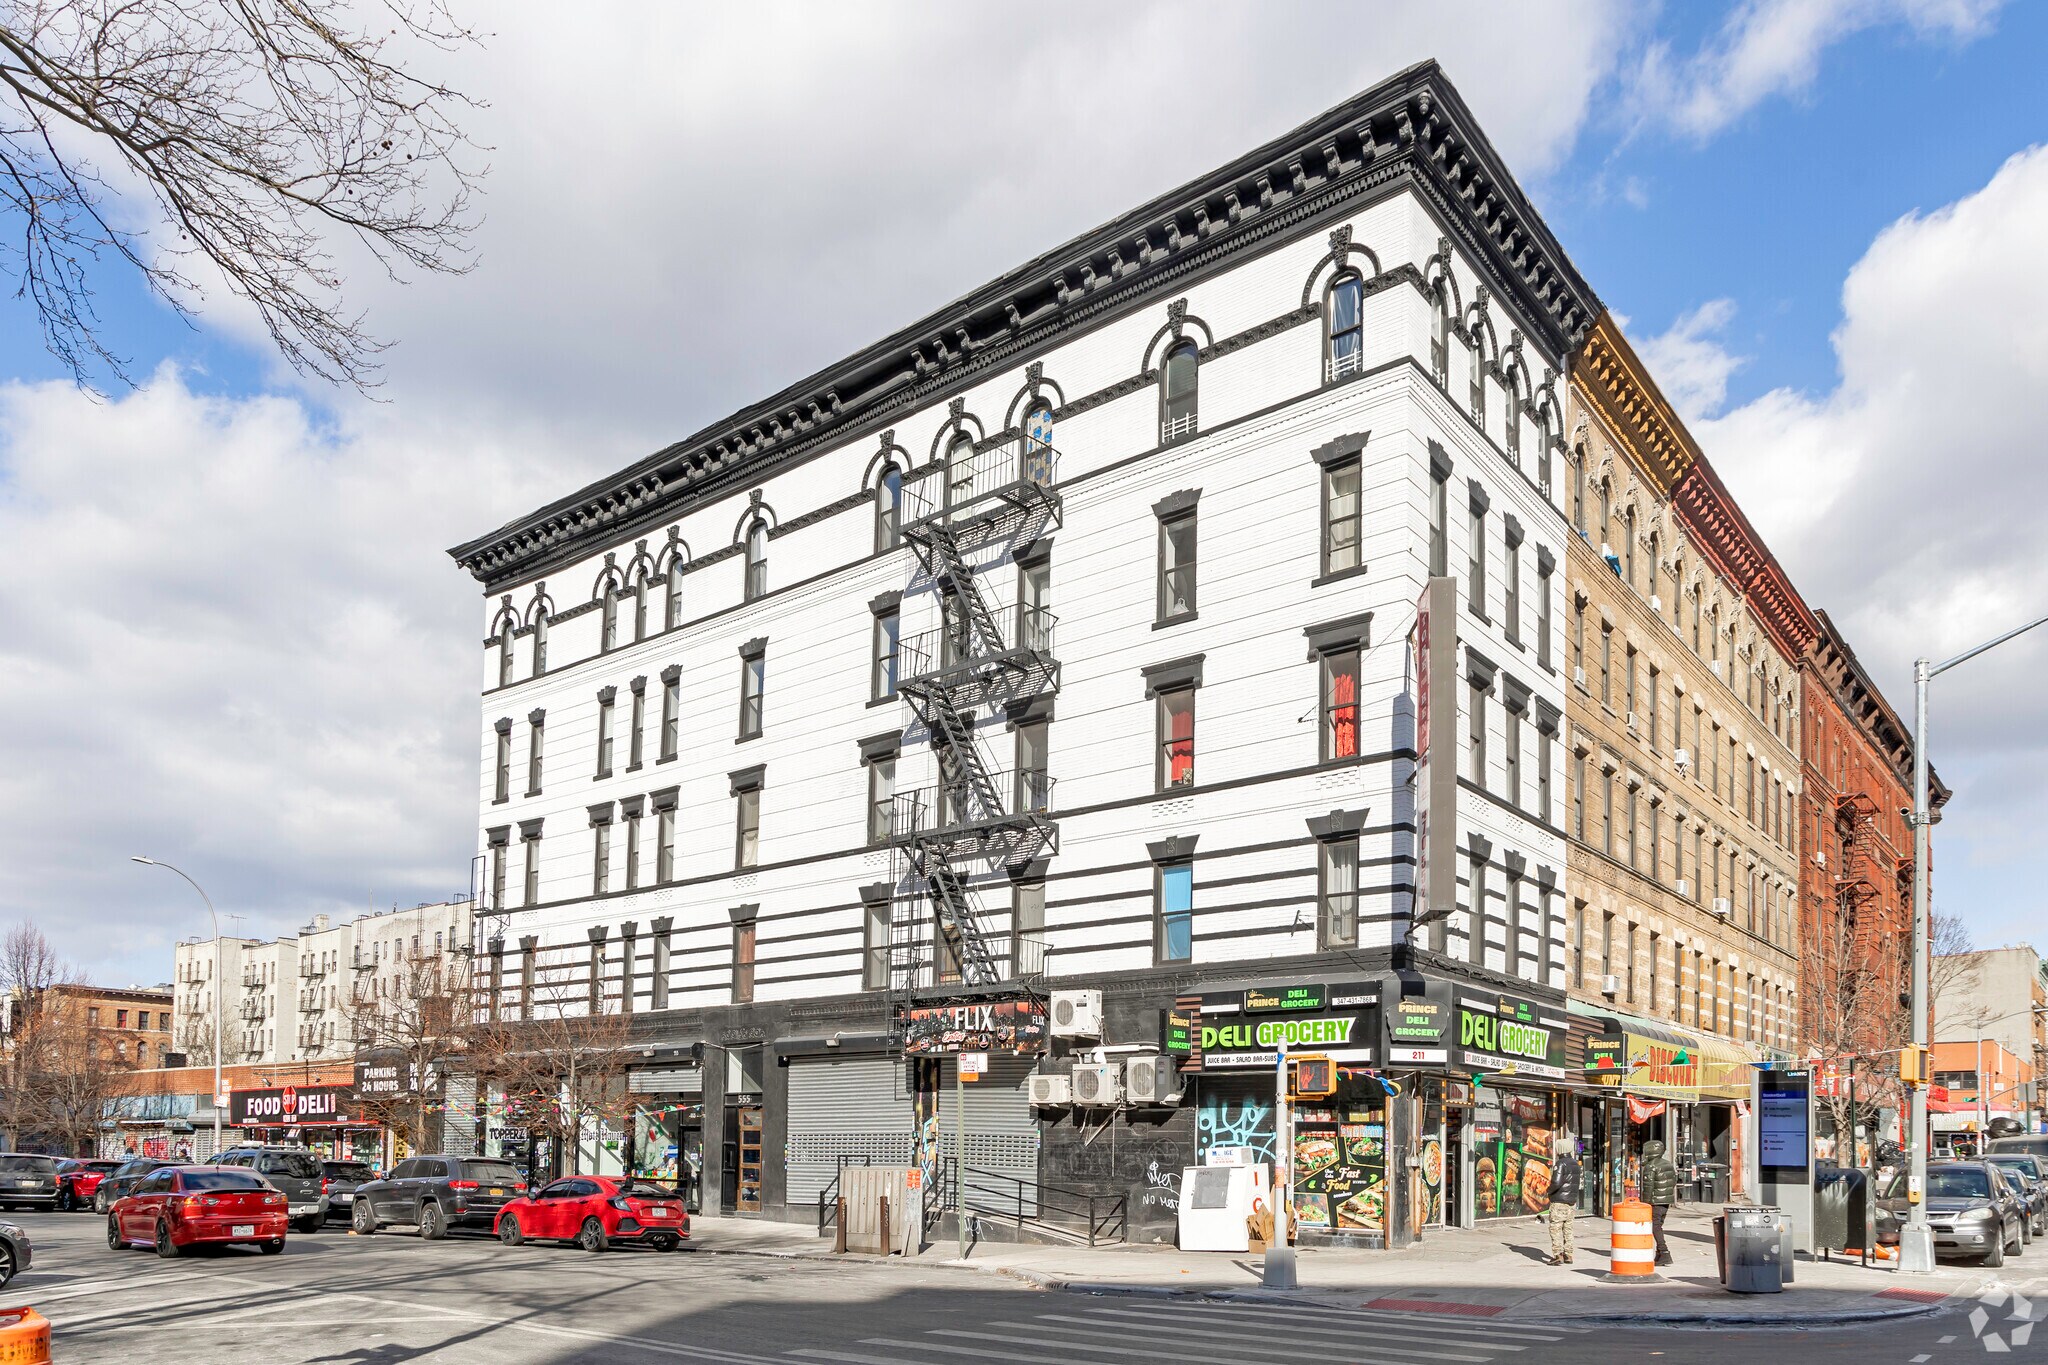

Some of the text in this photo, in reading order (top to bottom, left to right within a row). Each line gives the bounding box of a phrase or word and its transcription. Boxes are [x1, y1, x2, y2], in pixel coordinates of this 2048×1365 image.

[1287, 989, 1307, 998] DELI
[1247, 998, 1279, 1007] PRINCE
[1281, 998, 1319, 1008] GROCERY
[1519, 1002, 1528, 1012] DELI
[1398, 1004, 1438, 1014] PRINCE
[1500, 1004, 1515, 1015] PRINCE
[954, 1006, 995, 1031] FLIX
[1032, 1015, 1045, 1026] FLIX
[1406, 1016, 1429, 1025] DELI
[1516, 1012, 1532, 1022] GROCERY
[1169, 1018, 1190, 1027] PRINCE
[1173, 1030, 1186, 1039] DELI
[1201, 1020, 1350, 1049] DELI GROCERY
[1395, 1027, 1440, 1037] GROCERY
[1461, 1010, 1547, 1057] DELI GROCERY
[1167, 1041, 1191, 1050] GROCERY
[1588, 1041, 1621, 1049] PRINCE
[1236, 1055, 1252, 1063] SALAD
[1412, 1051, 1425, 1060] 211
[364, 1066, 397, 1079] PARKING
[362, 1080, 399, 1091] 24 HOURS
[1601, 1074, 1621, 1087] UNT
[247, 1097, 281, 1116] FOOD
[298, 1093, 329, 1115] DELI
[738, 1095, 751, 1104] 555
[1337, 1166, 1361, 1180] Fast
[1325, 1178, 1351, 1193] Food
